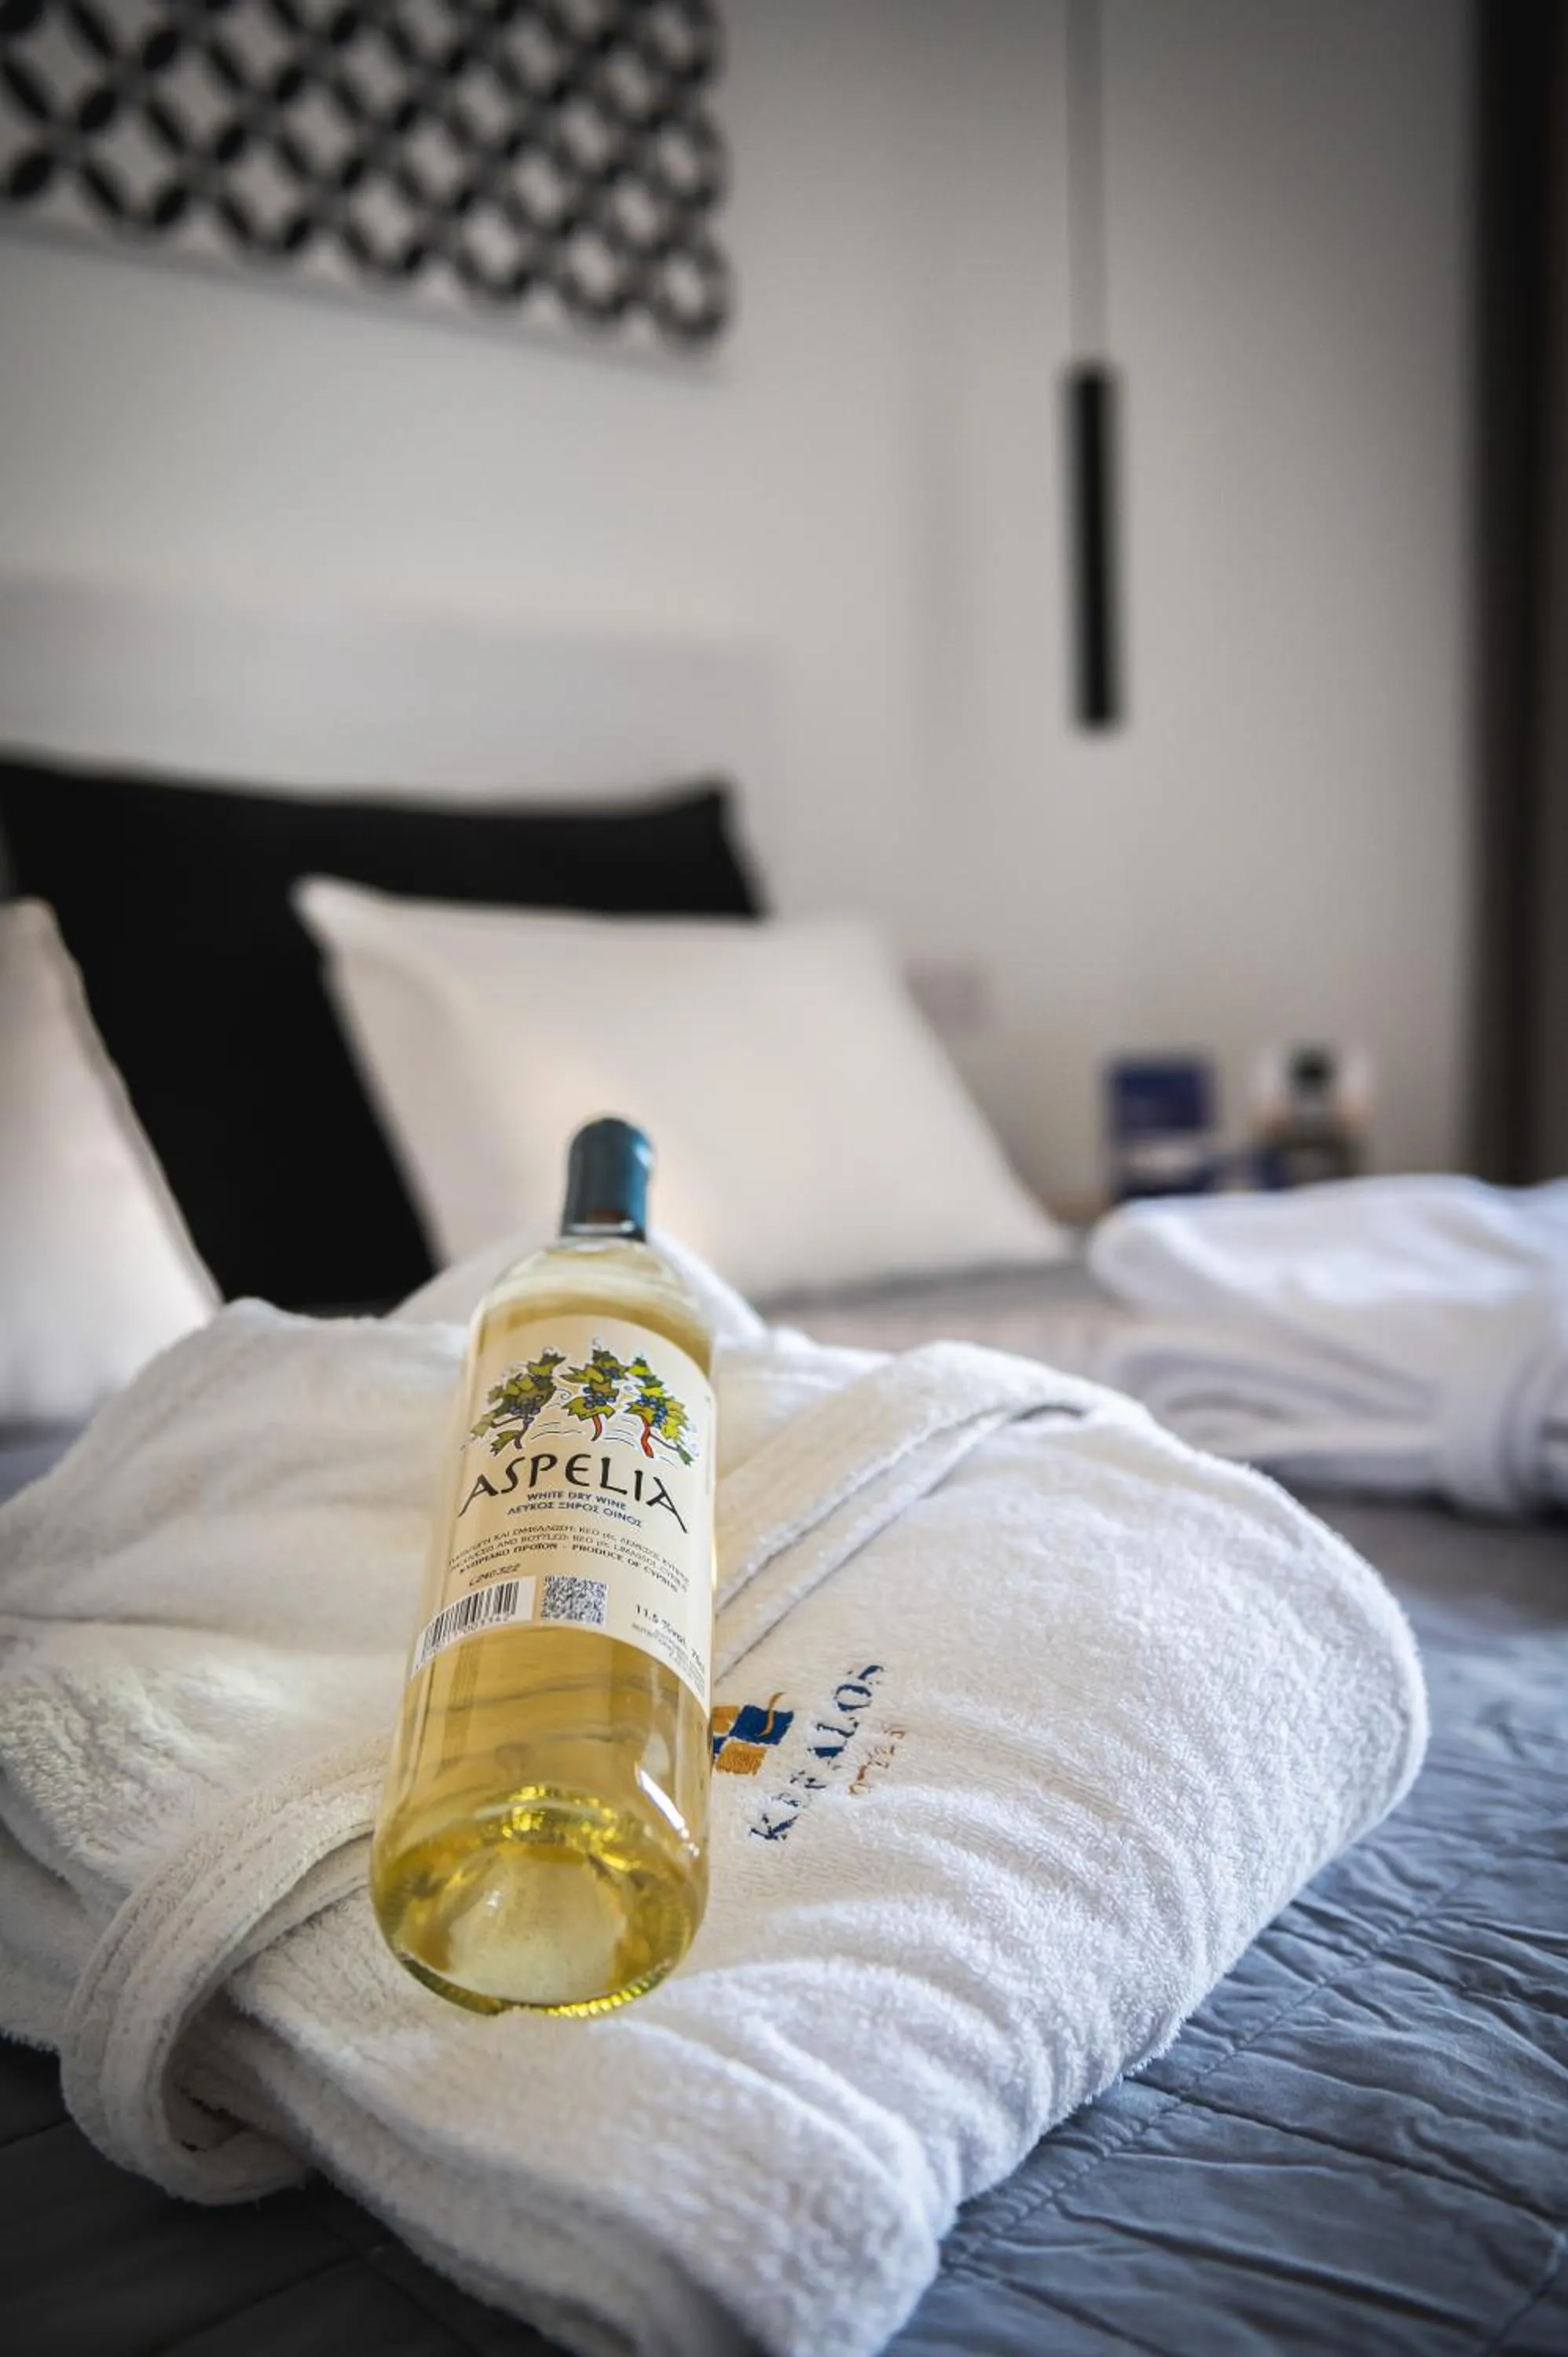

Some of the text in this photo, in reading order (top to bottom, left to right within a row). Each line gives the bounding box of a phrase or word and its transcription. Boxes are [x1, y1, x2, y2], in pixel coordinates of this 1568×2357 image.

[458, 1453, 688, 1534] ASPELIA
[527, 1490, 627, 1510] WHITE DRY WINE
[507, 1501, 642, 1527] ΛΕΥΚΟΣ ΞΗΡΟΣ ΟΙΝΟΣ
